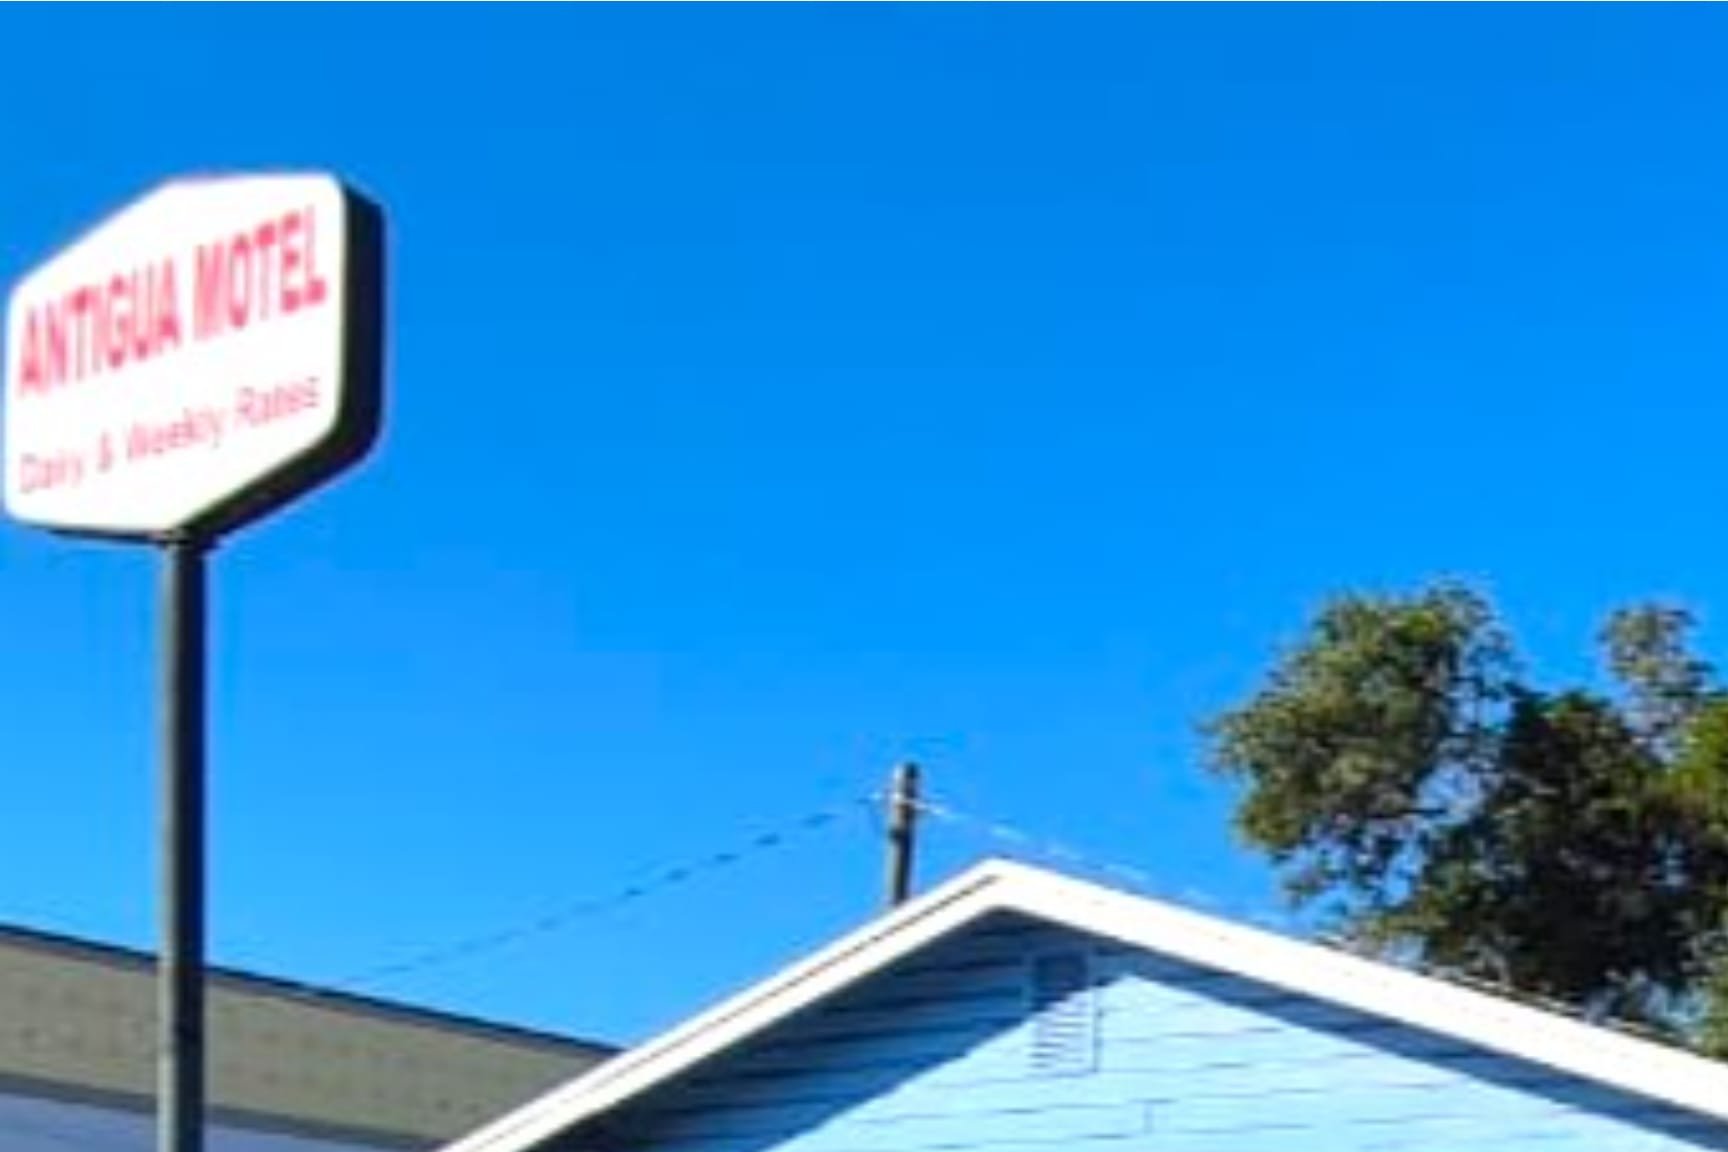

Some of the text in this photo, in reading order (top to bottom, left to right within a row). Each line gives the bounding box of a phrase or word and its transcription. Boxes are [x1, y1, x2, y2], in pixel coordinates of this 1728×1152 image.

[20, 205, 327, 396] ANTIGUA MOTEL
[20, 451, 82, 494] Daily
[127, 406, 227, 462] Weekly
[236, 376, 320, 427] Rates
